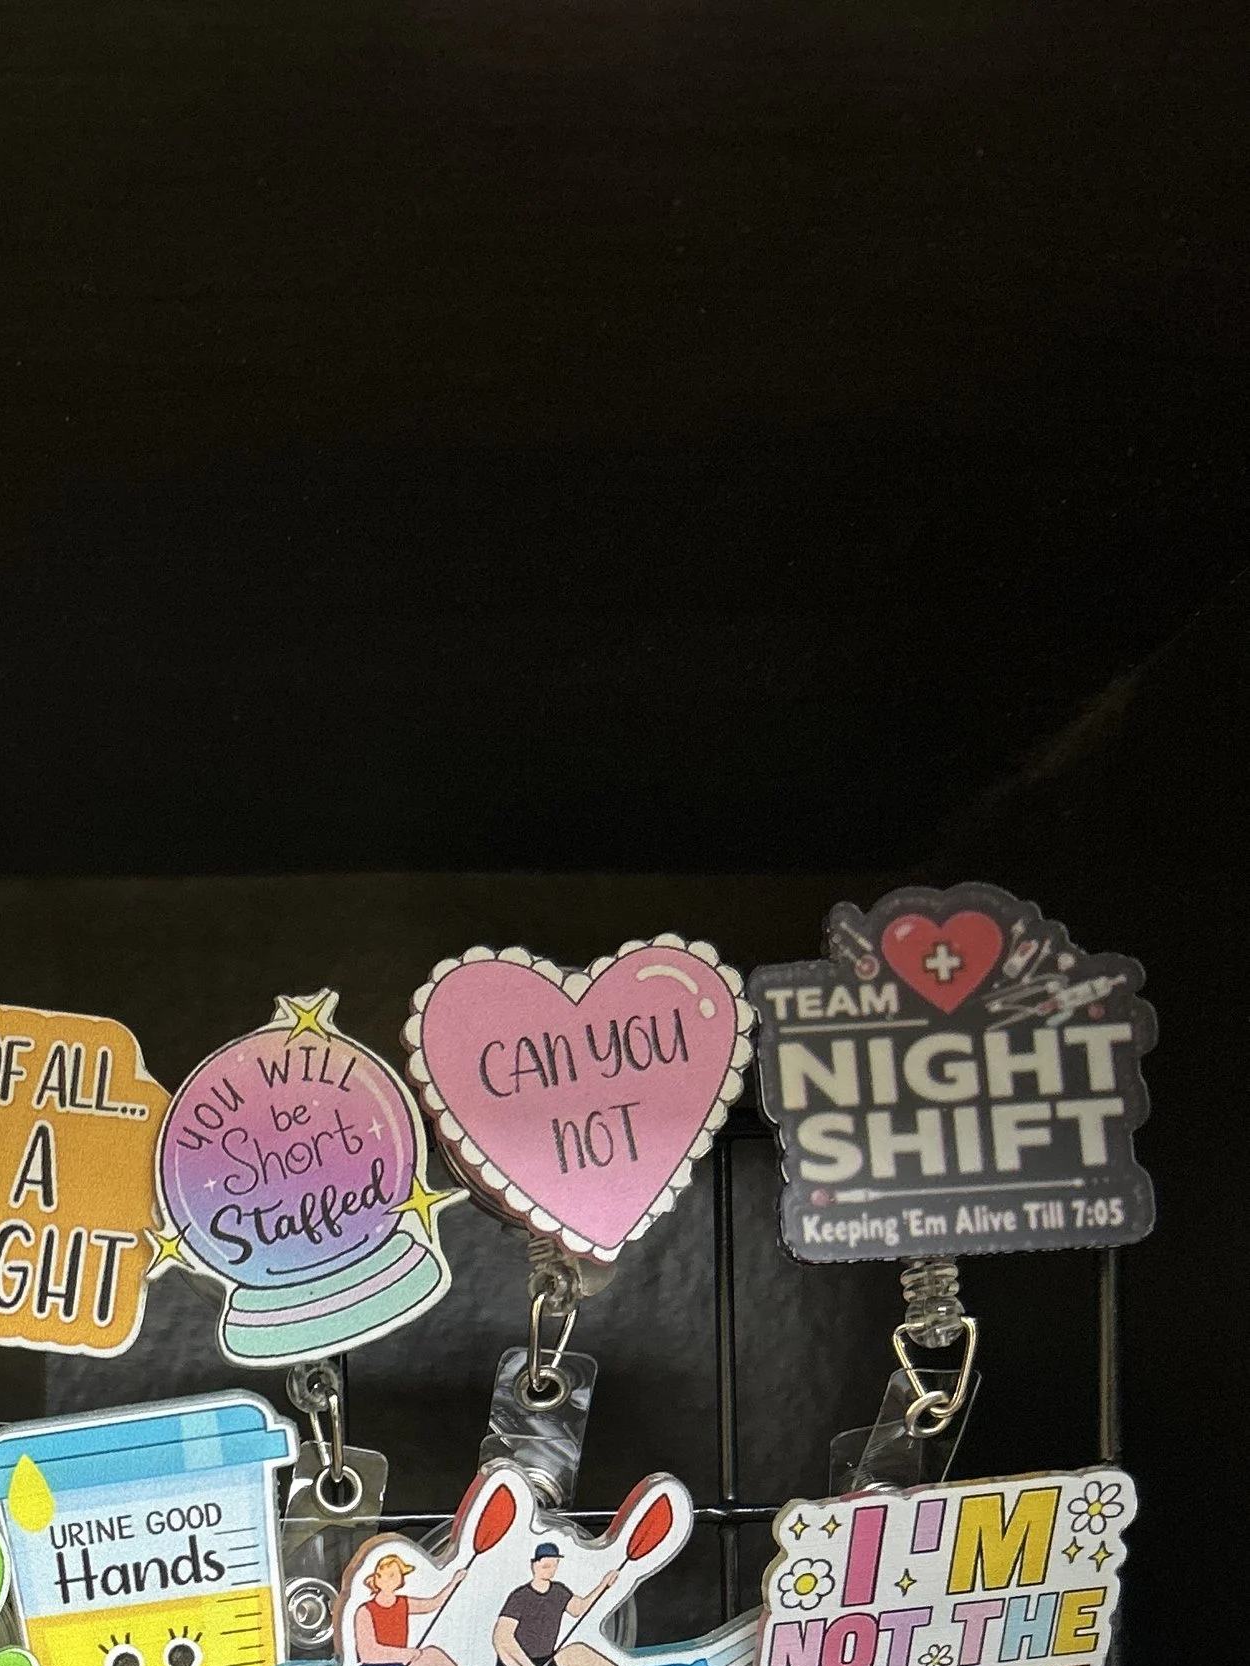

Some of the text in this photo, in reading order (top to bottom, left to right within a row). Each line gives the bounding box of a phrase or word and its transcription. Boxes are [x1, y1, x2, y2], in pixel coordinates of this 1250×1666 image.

[765, 982, 900, 1020] TEAM
[41, 1044, 149, 1120] ALL...
[257, 1046, 357, 1093] WILL
[774, 1024, 1134, 1110] NIGHT
[221, 1108, 364, 1196] Short
[270, 1103, 312, 1133] be
[795, 1099, 1125, 1184] SHIFT
[15, 1124, 54, 1207] A
[210, 1158, 393, 1264] Staffed
[802, 1213, 899, 1248] Keeping
[903, 1207, 947, 1238] 'Em
[955, 1205, 1017, 1235] Alive
[1022, 1202, 1065, 1229] Till
[50, 1502, 223, 1549] URINE GOOD
[841, 1488, 1061, 1607] I'M
[55, 1538, 228, 1604] Hands
[952, 1587, 1105, 1666] THE
